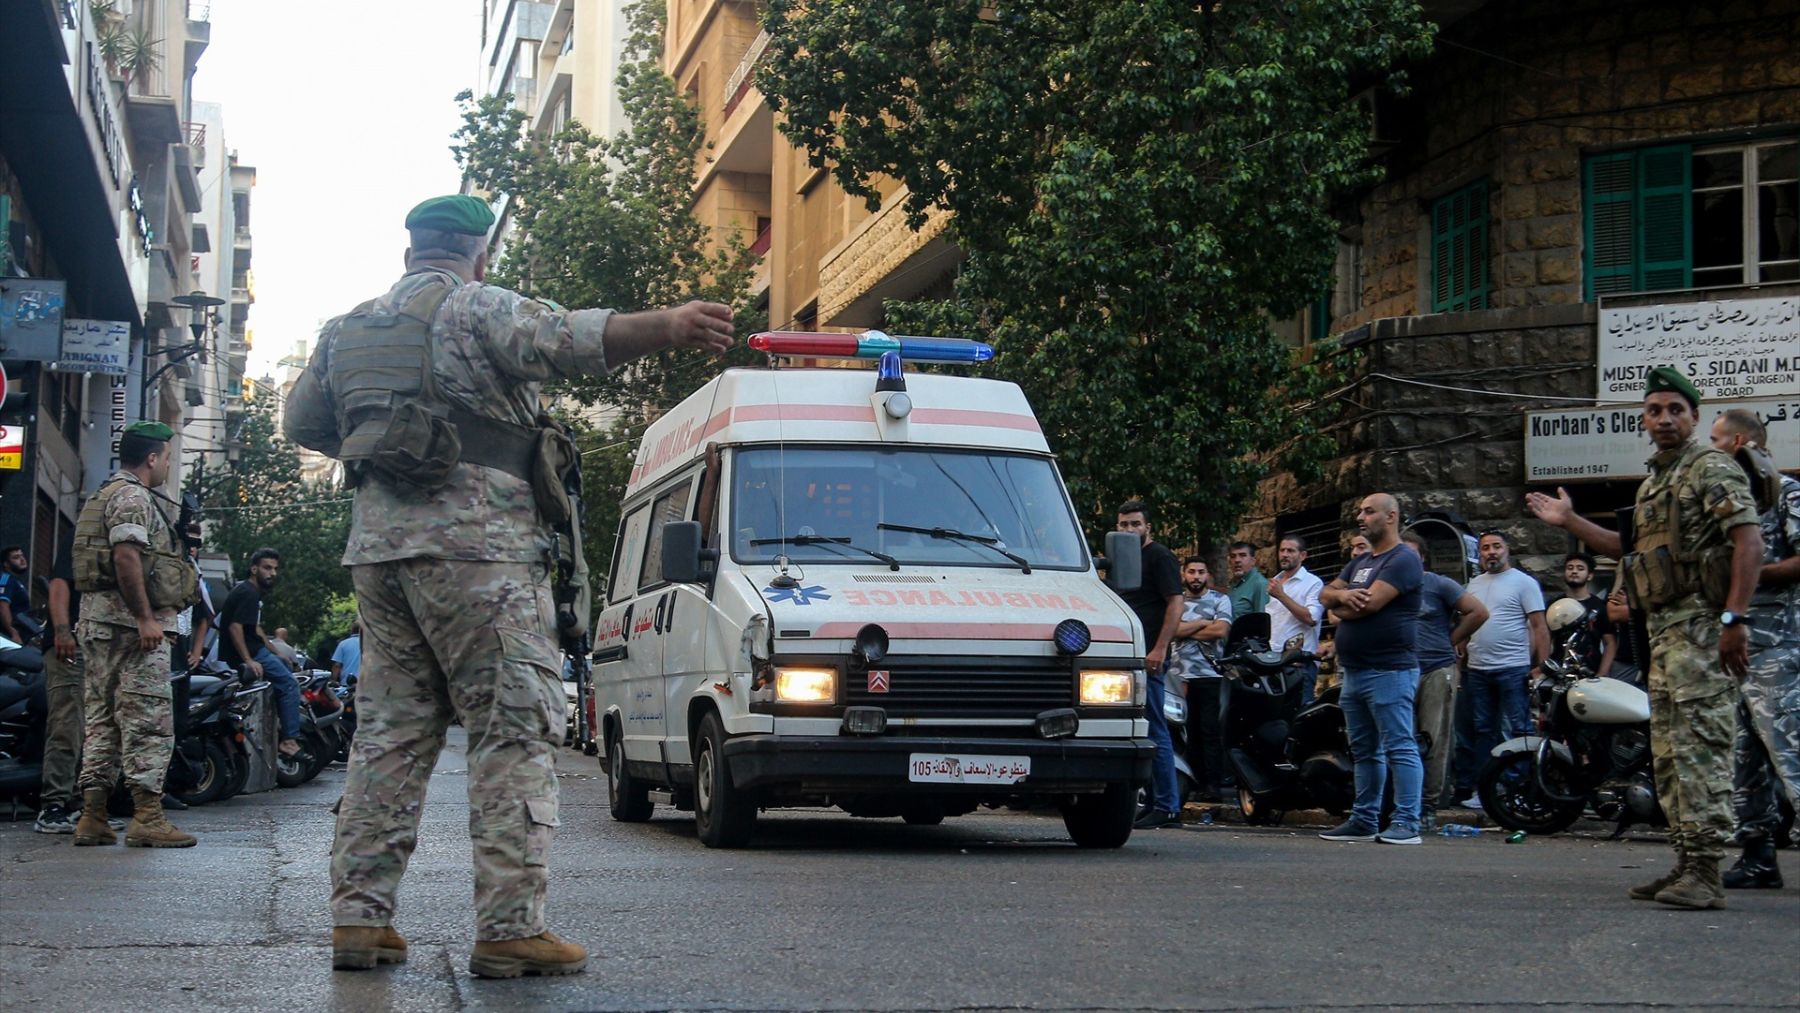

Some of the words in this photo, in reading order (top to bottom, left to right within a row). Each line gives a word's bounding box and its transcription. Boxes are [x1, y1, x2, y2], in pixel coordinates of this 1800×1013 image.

[1708, 359, 1768, 375] SIDANI
[1745, 374, 1794, 385] SURGEON
[1717, 387, 1754, 396] BOARD
[1532, 413, 1605, 437] Korban's
[1532, 465, 1584, 476] Established
[1587, 464, 1609, 474] 1947
